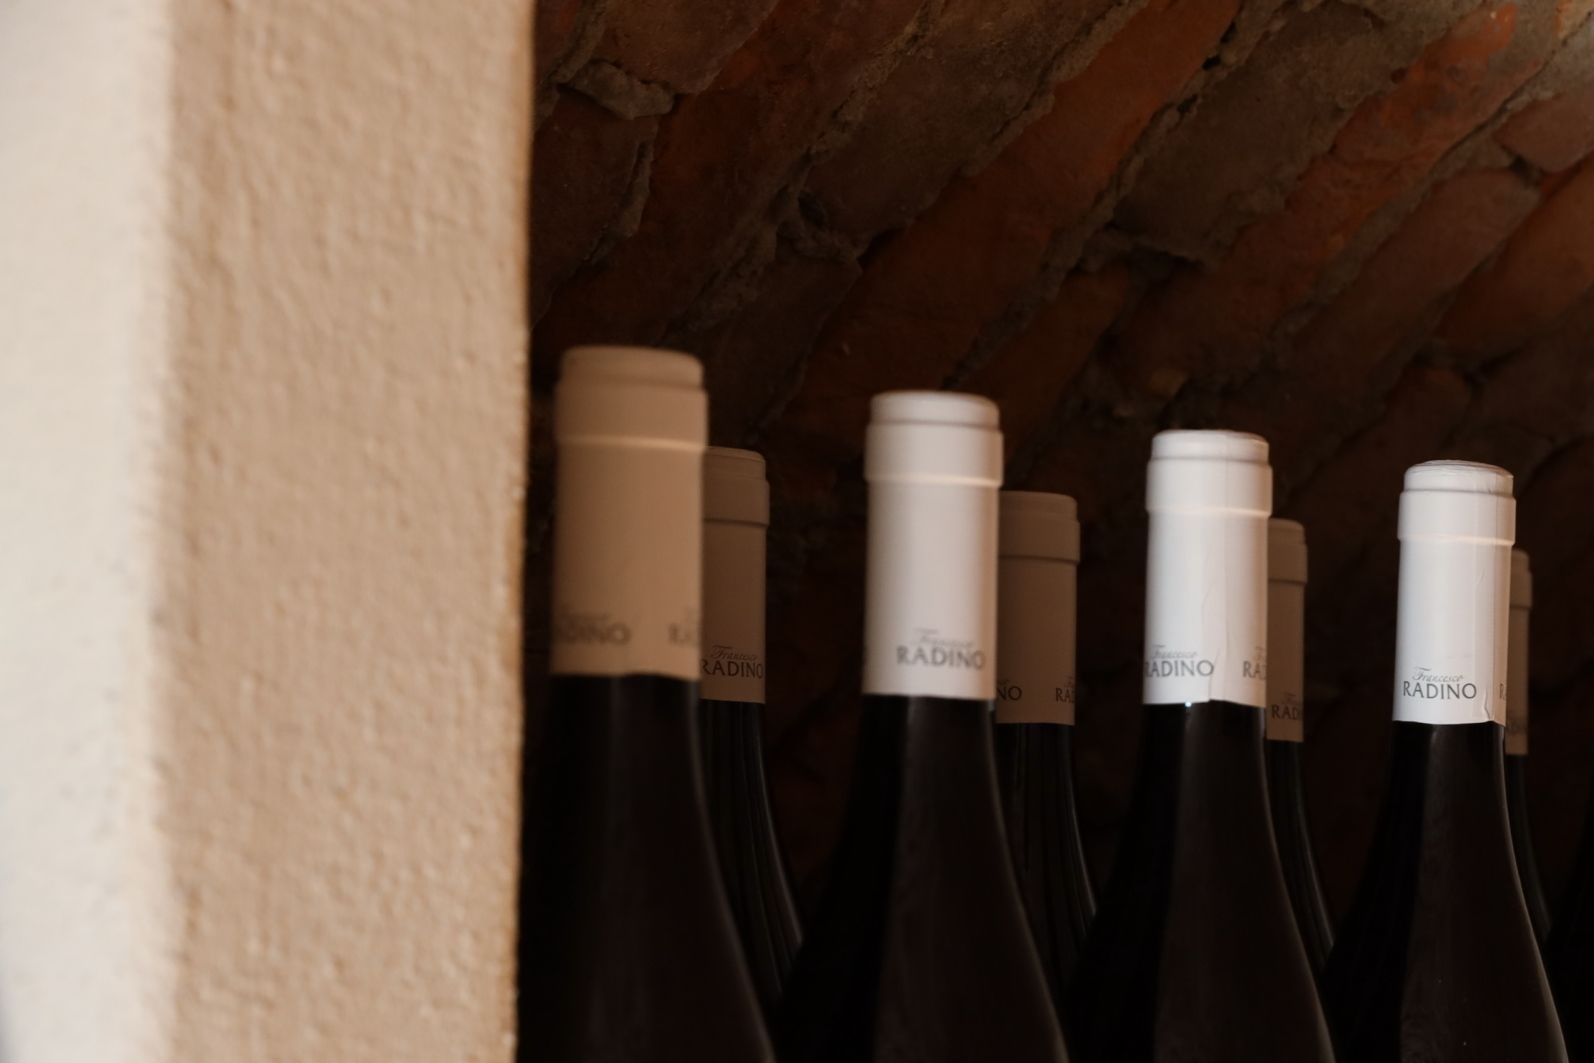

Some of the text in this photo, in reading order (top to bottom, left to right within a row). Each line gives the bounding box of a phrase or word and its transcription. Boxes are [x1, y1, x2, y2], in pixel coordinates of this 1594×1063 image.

[896, 646, 987, 671] RADINO
[1412, 667, 1465, 681] Francesco
[1403, 681, 1477, 700] RADINO
